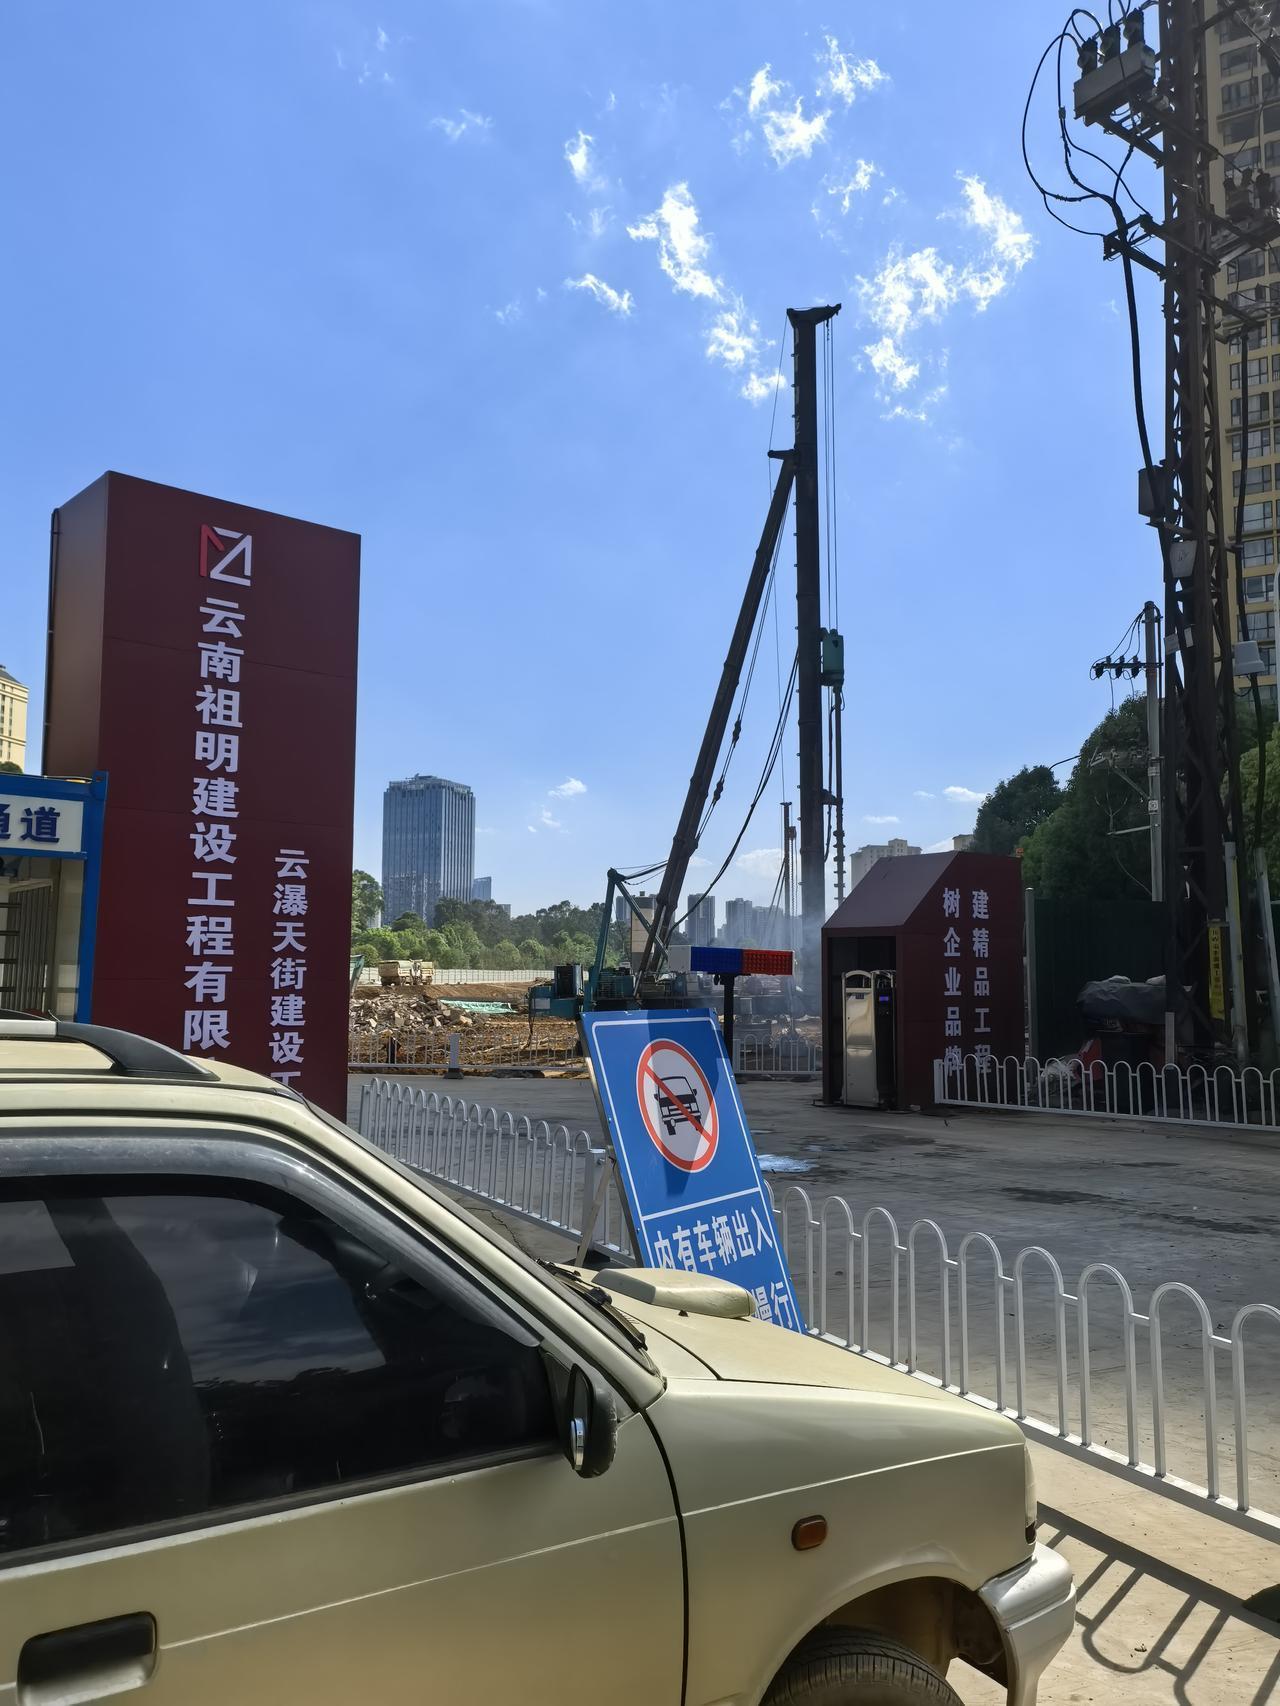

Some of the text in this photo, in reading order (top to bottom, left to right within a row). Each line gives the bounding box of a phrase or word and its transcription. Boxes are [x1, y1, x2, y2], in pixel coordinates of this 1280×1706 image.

[183, 597, 246, 1060] 云南祖明建设工程有限
[943, 888, 963, 1076] 树企业品牌
[972, 890, 992, 1073] 建精品工程
[654, 1207, 773, 1272] 内有车辆出入
